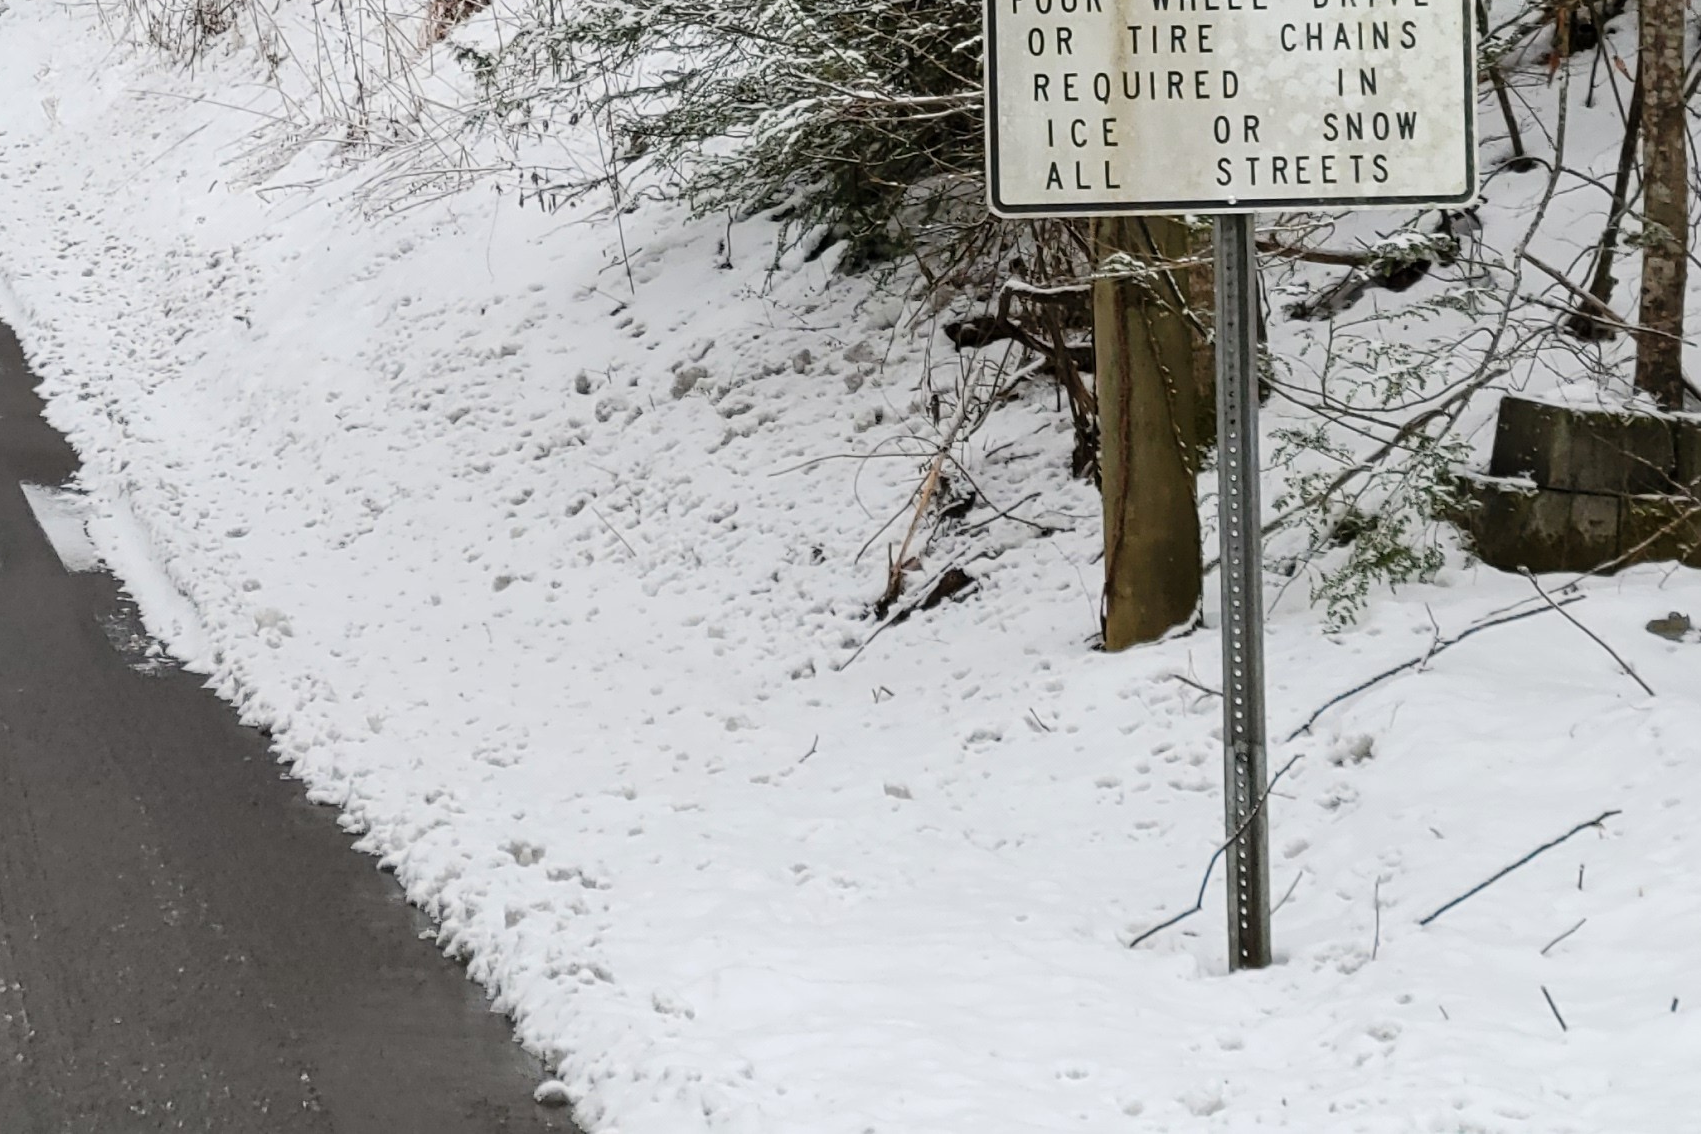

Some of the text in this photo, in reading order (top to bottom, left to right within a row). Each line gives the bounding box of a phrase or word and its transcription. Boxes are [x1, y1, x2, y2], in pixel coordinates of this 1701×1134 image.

[1028, 20, 1417, 57] OR TIRE CHAINS
[1034, 67, 1377, 105] REQUIRED IN
[1047, 111, 1417, 148] ICE OR SNOW
[1046, 154, 1388, 190] ALL STREETS
